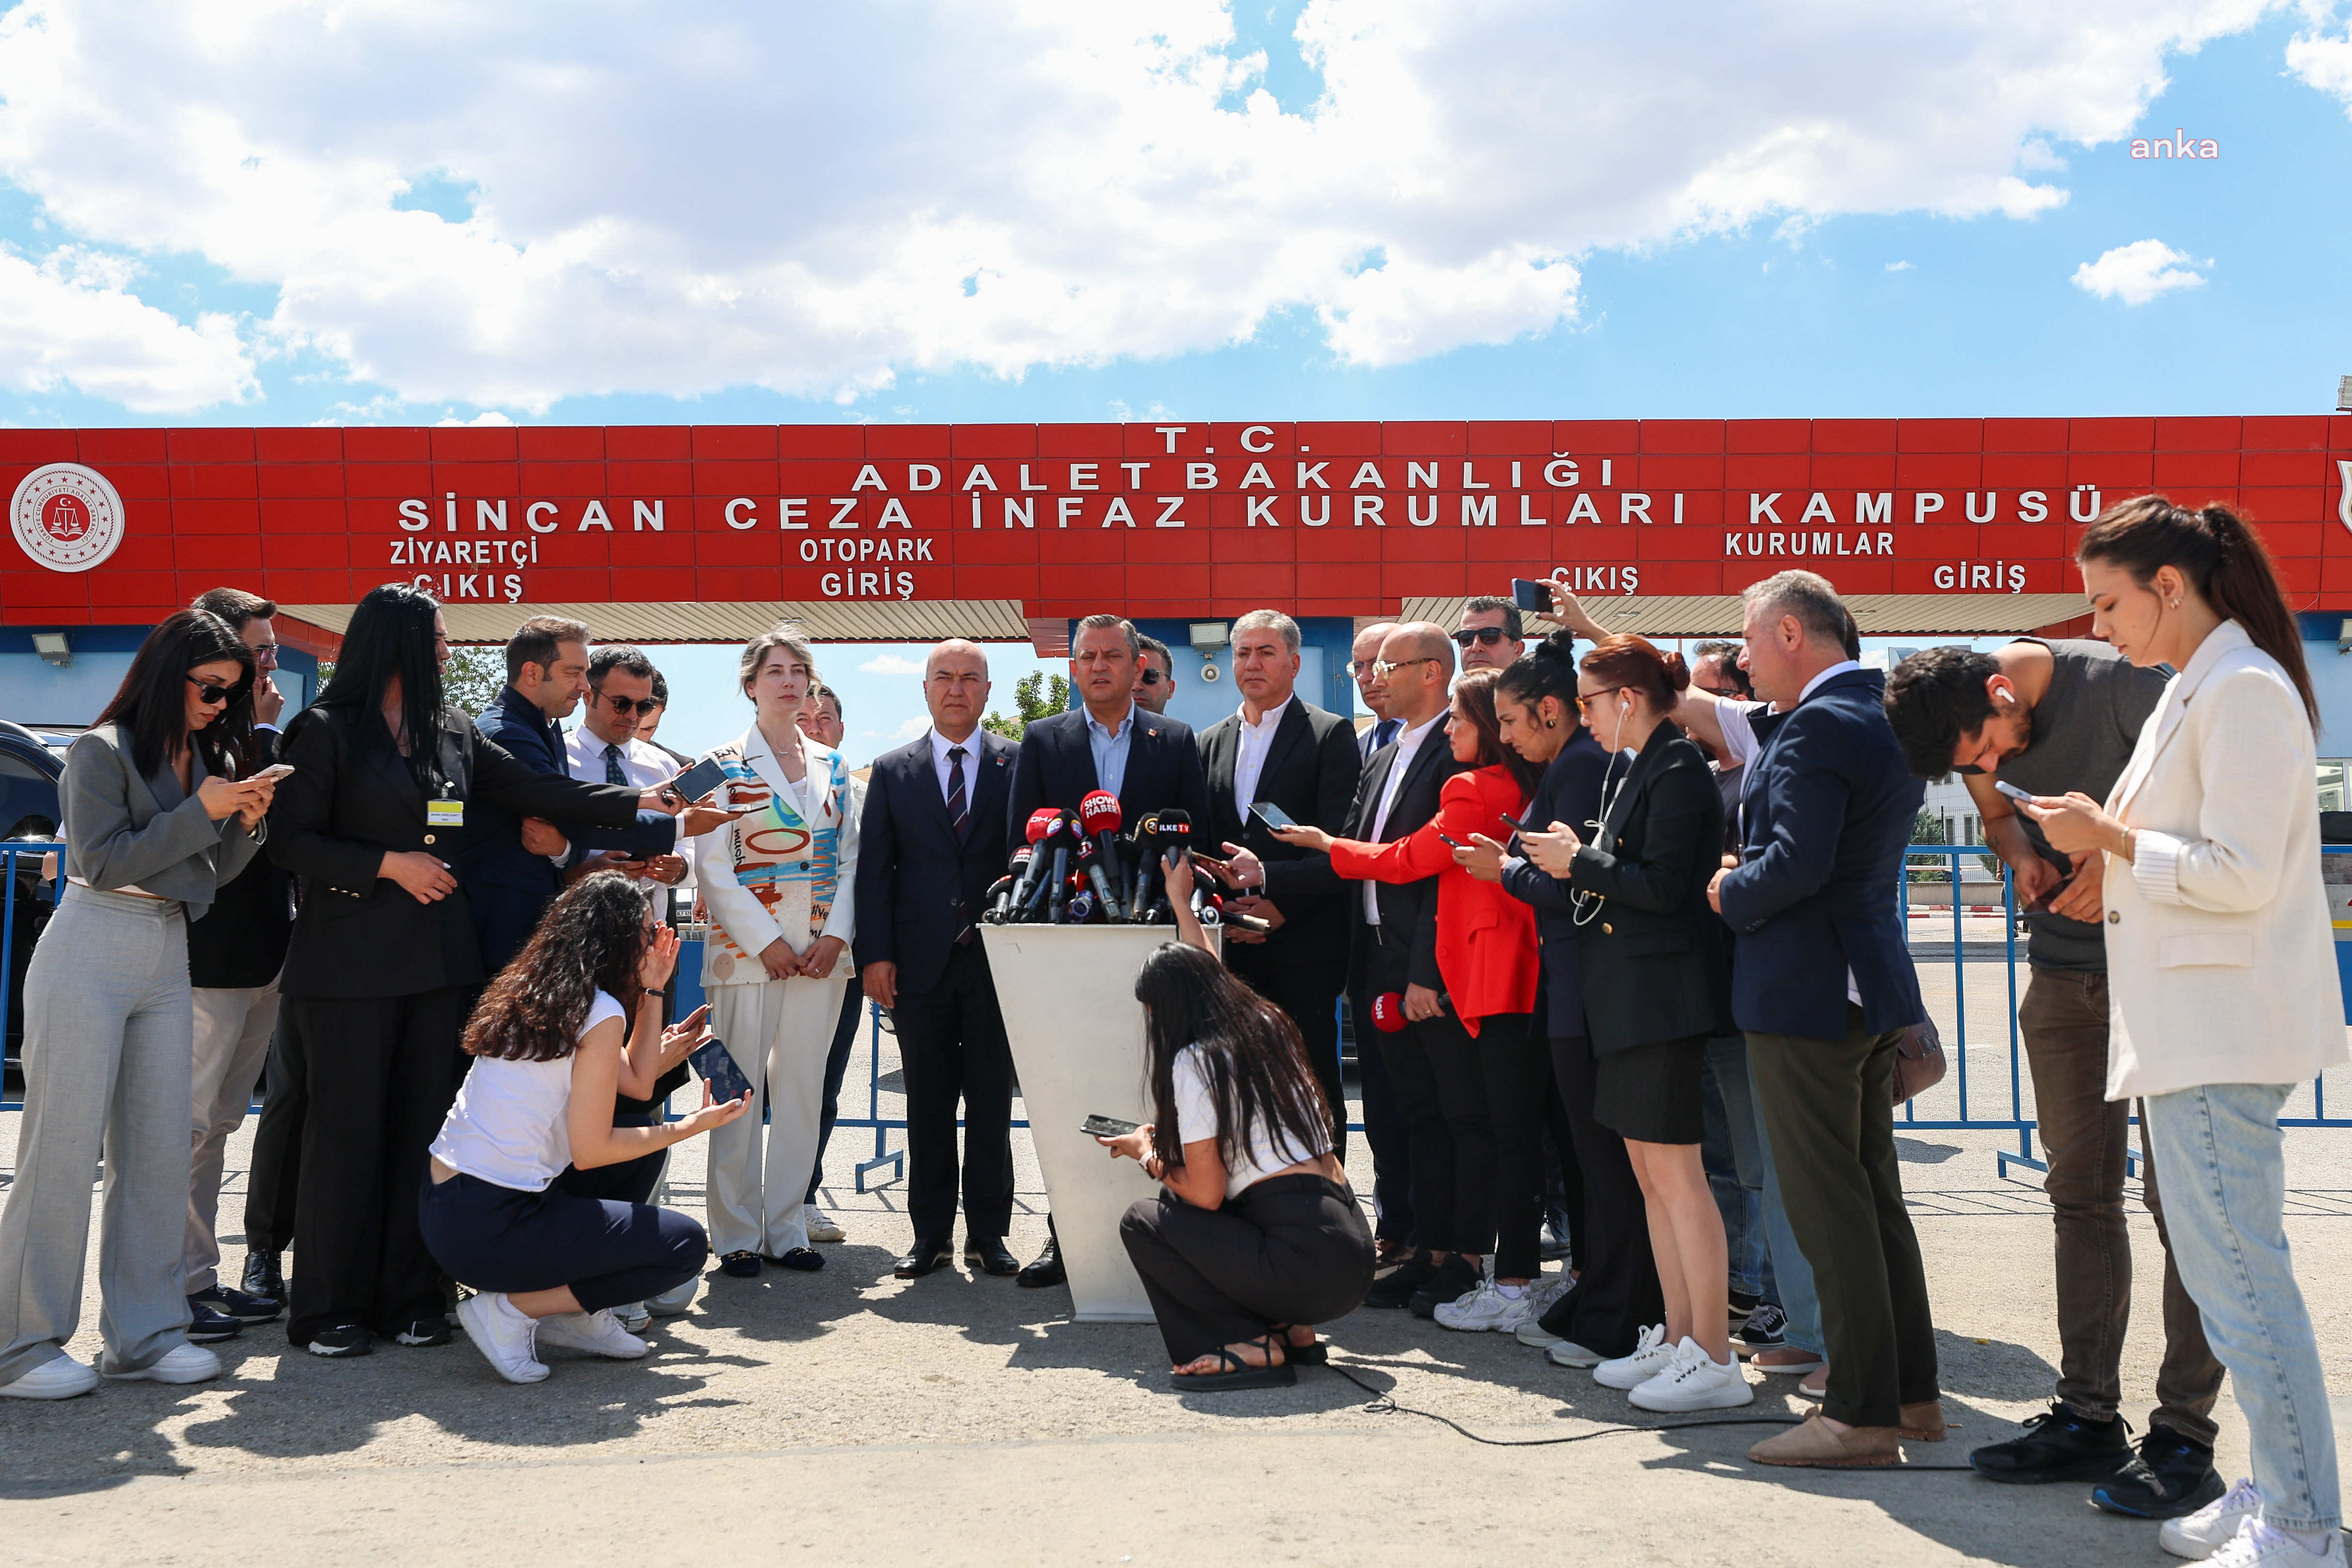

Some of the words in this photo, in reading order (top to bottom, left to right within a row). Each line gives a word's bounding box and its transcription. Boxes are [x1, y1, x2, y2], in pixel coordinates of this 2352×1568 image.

[851, 462, 1151, 491] ADALET
[1186, 451, 1612, 490] BAKANLIĞI
[35, 487, 69, 516] CUMHURİYETİ
[71, 489, 93, 508] ADALET
[398, 492, 665, 533] SİNCAN
[725, 497, 913, 530] CEZA
[972, 491, 1185, 528] İNFAZ
[1247, 493, 1684, 527] KURUMLARI
[1750, 484, 2101, 524] KAMPUSÜ
[81, 509, 96, 543] BAKANLIĞI
[390, 535, 538, 569] ZİYARETÇİ
[800, 538, 934, 562] OTOPARK
[1726, 532, 1894, 556] KURUMLAR
[821, 567, 914, 601] GİRİŞ
[1933, 560, 2026, 594] GİRİŞ
[1084, 795, 1116, 810] SHOW
[1085, 804, 1118, 819] HABER
[1178, 824, 1189, 832] TV
